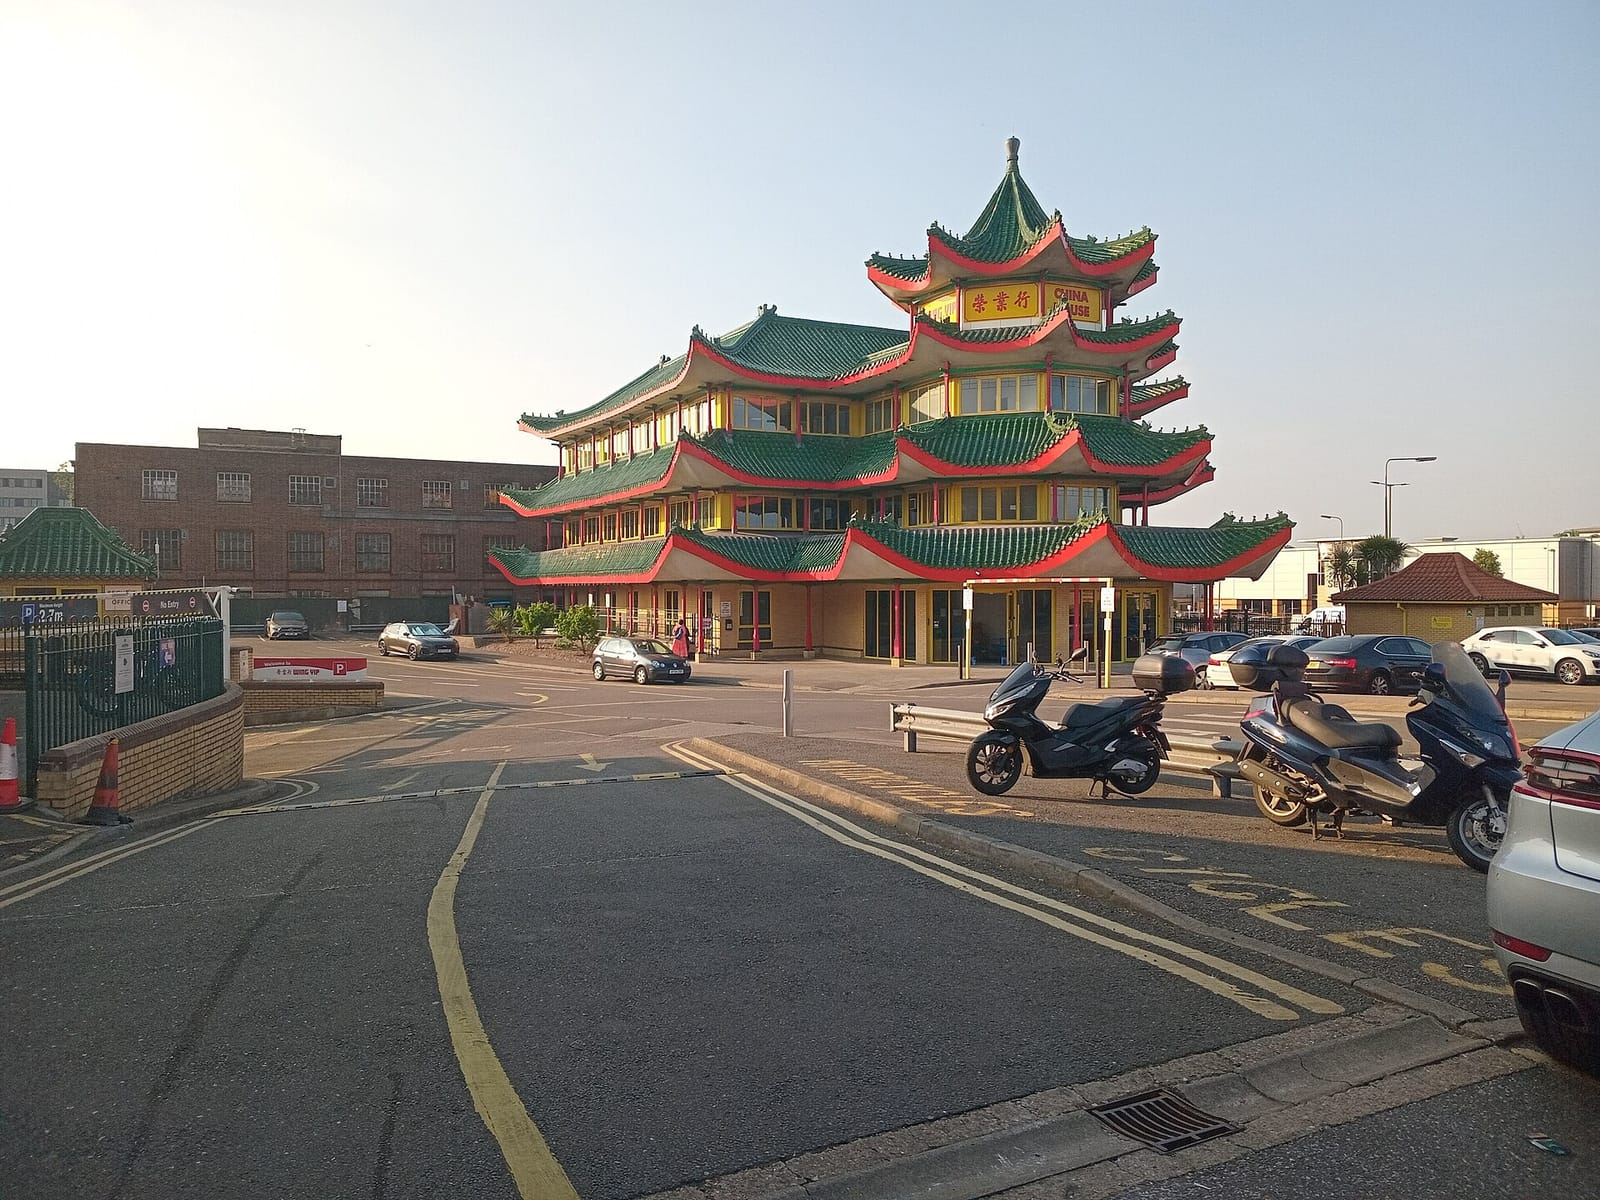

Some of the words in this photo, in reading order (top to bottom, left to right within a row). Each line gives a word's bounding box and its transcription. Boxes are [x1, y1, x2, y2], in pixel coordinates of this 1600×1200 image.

[167, 600, 179, 609] Entry
[39, 609, 63, 622] 2.7m
[336, 663, 344, 674] P
